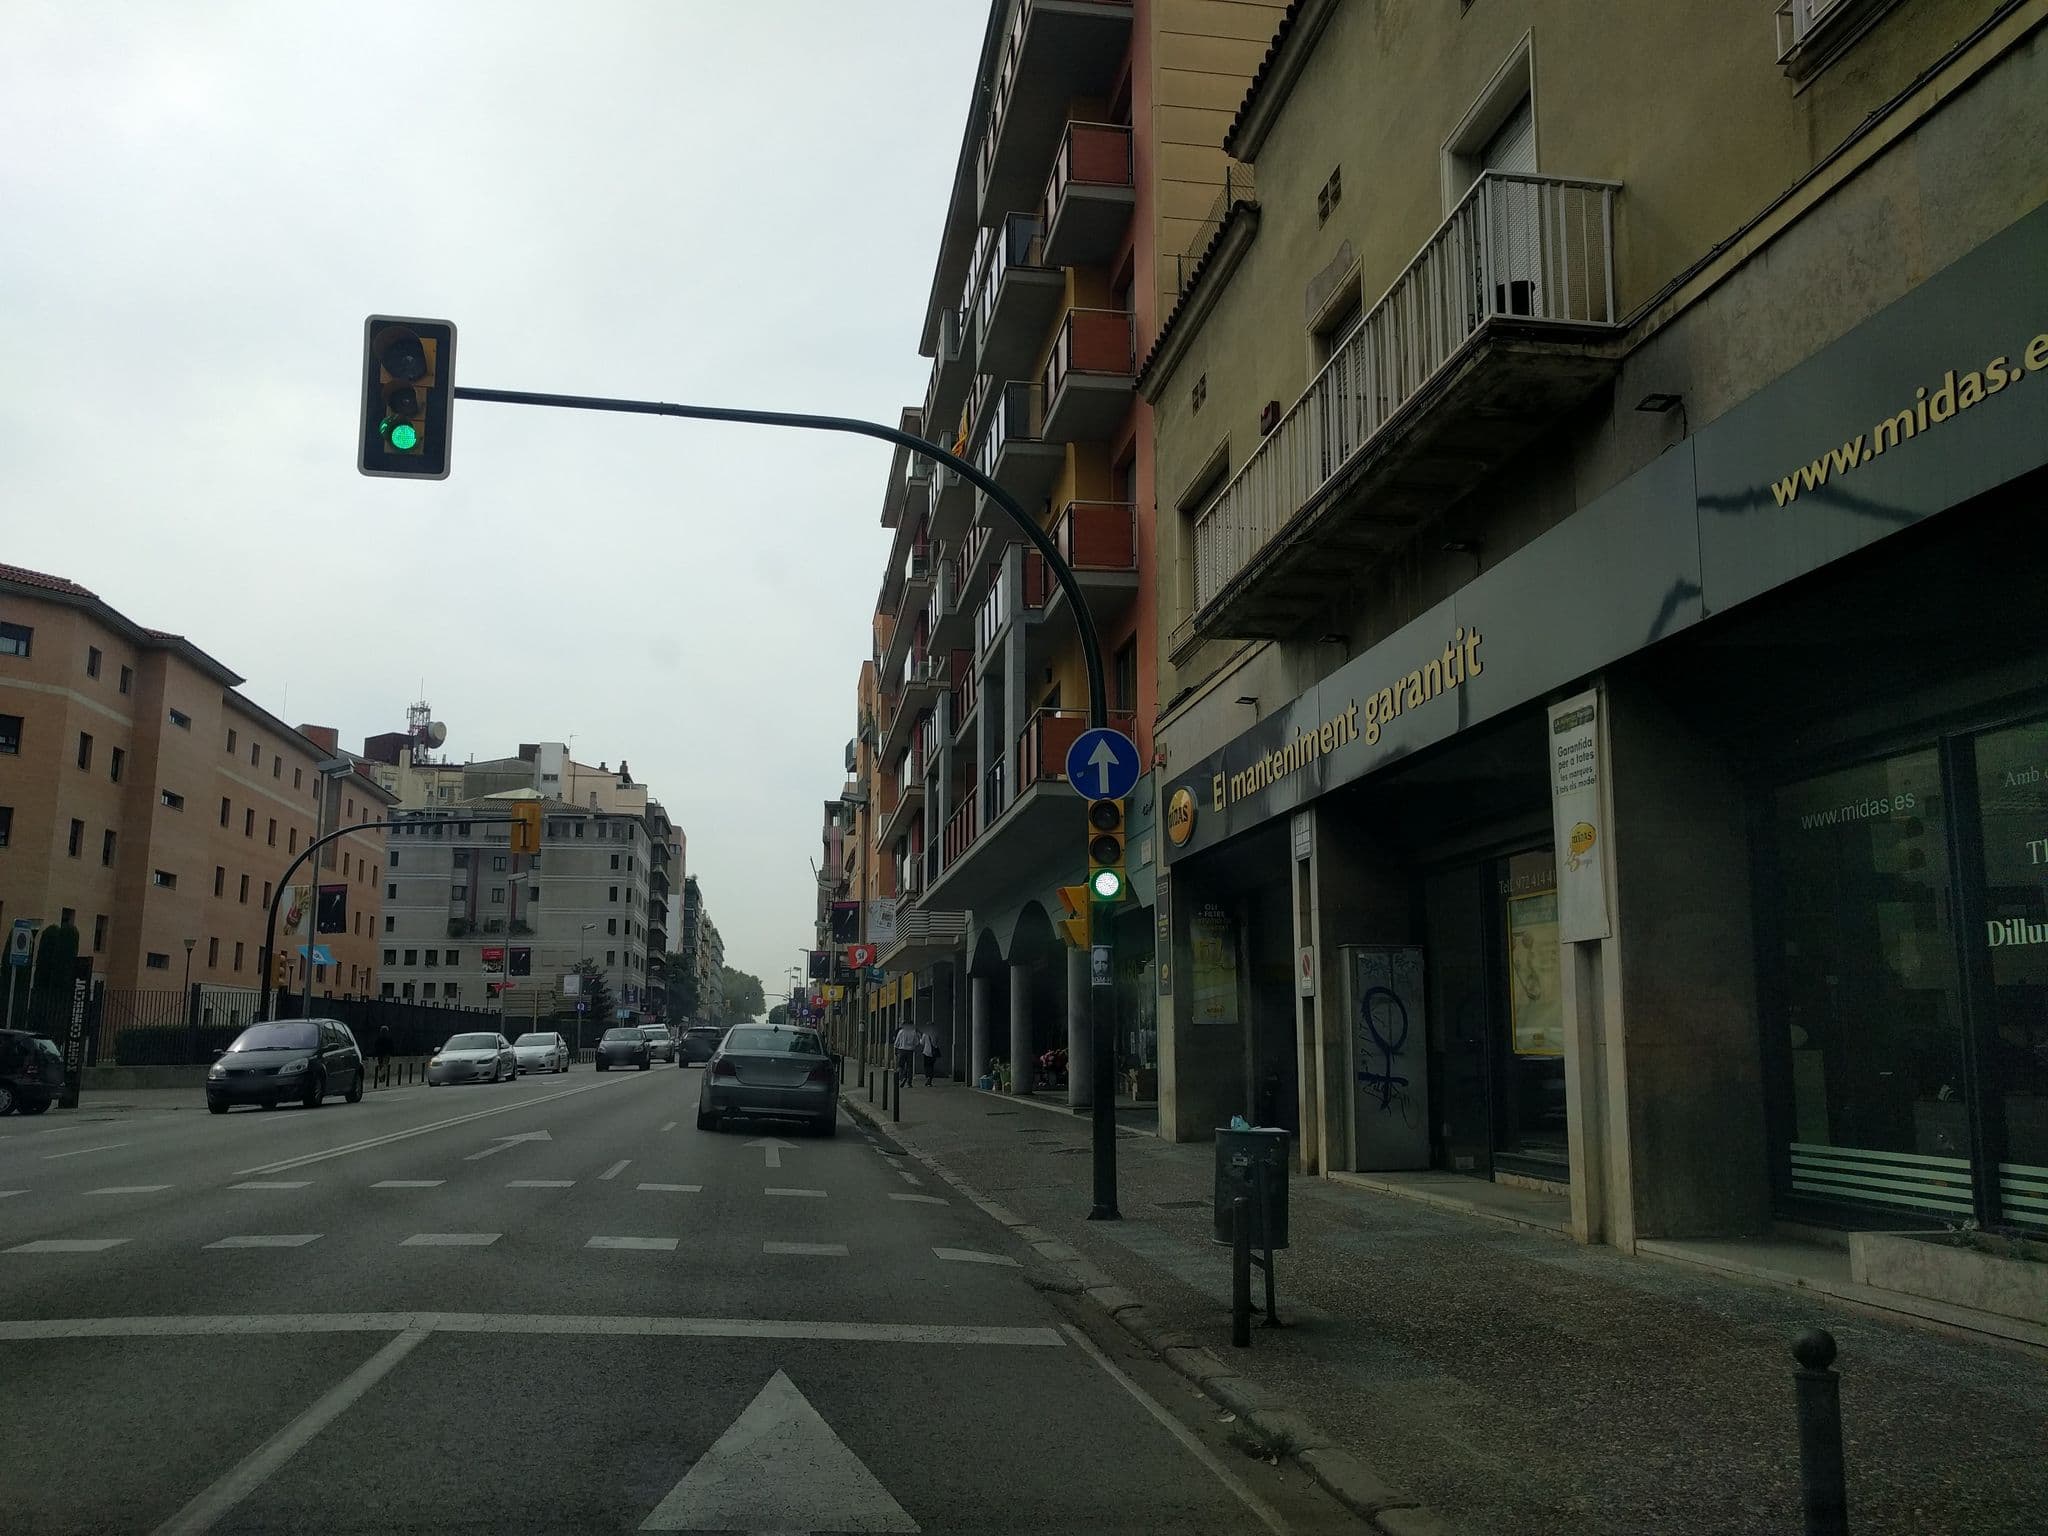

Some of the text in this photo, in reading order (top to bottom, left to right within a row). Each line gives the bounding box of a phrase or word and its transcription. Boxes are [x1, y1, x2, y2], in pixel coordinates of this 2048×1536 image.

[1212, 626, 1484, 814] El manteniment garantit
[1557, 736, 1593, 757] Garantida
[1800, 792, 1916, 832] www.midas.es
